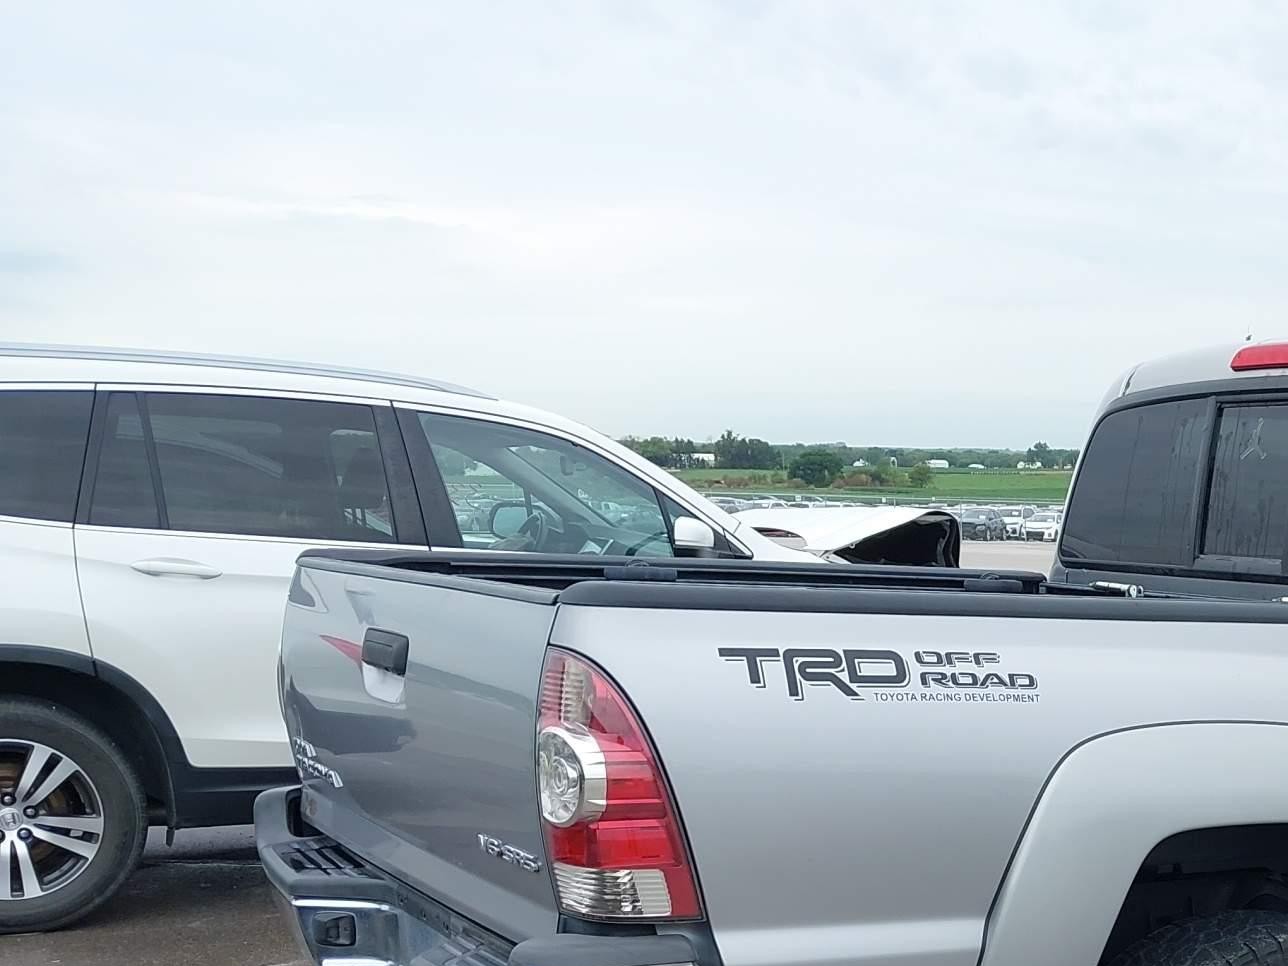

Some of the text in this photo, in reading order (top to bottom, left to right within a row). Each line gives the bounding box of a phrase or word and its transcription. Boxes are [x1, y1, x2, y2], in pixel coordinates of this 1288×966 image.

[914, 651, 1000, 667] OFF
[718, 647, 911, 701] TRD
[920, 672, 1038, 690] ROAD
[873, 692, 1041, 703] TOYOTA RACING DEVELOPMENT
